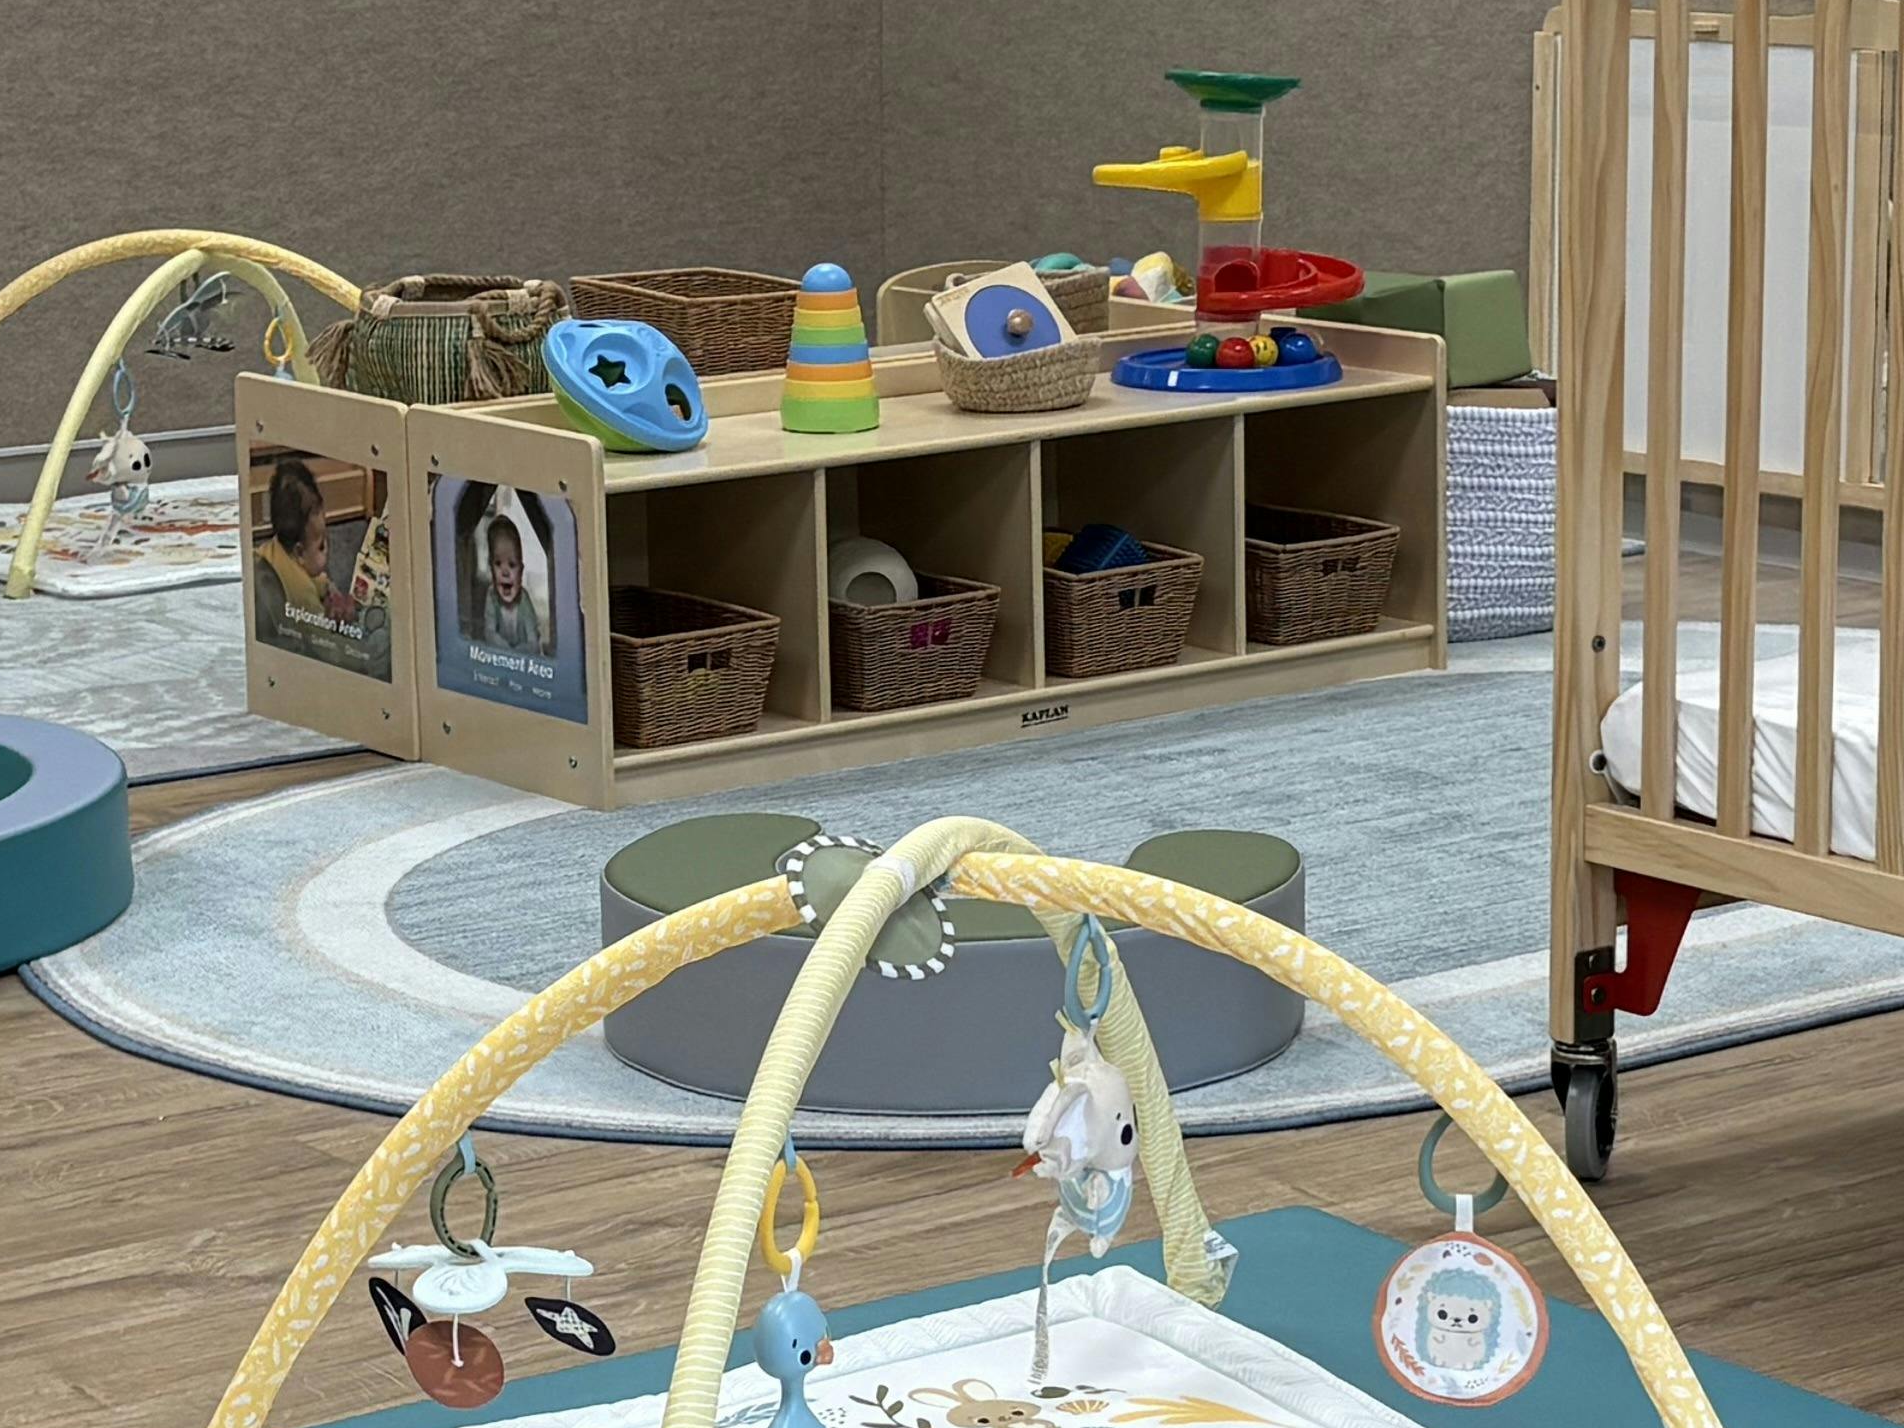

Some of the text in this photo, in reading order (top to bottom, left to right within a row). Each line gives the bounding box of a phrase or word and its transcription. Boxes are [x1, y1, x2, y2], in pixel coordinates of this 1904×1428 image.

[284, 602, 337, 631] Exploration
[338, 619, 363, 640] Area
[469, 644, 554, 679] Movement Area
[1021, 704, 1069, 723] KAPLAN
